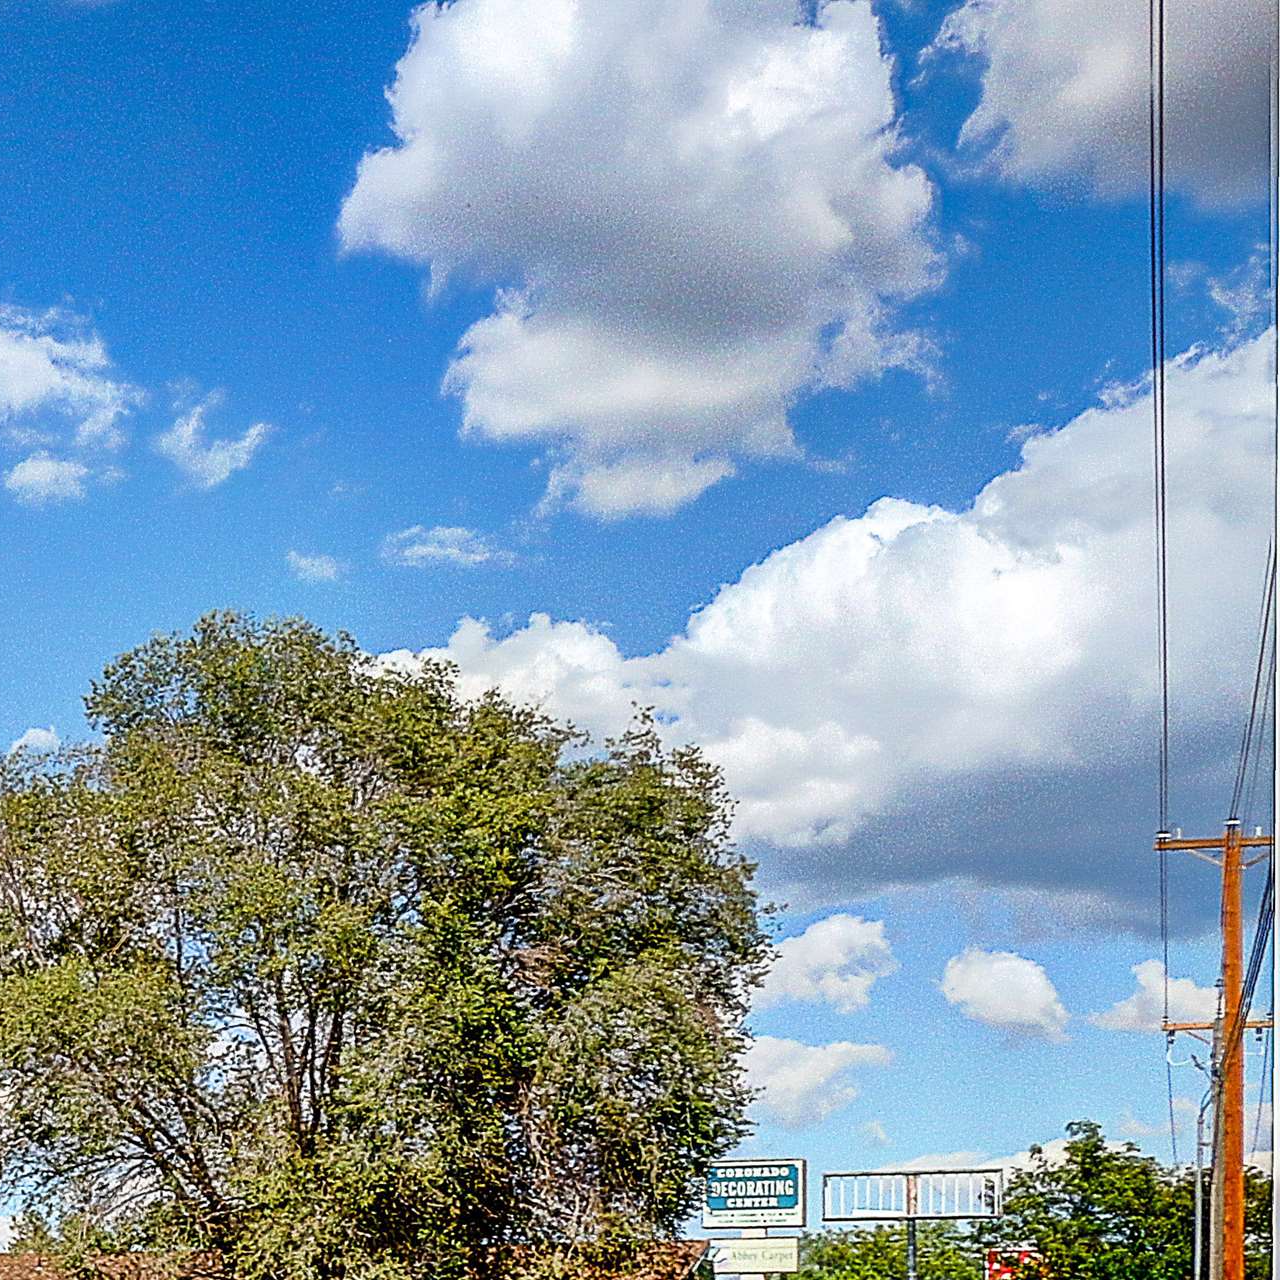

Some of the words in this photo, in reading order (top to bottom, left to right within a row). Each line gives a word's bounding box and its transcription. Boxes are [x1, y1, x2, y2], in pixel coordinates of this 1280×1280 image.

[716, 1166, 790, 1178] CORONADO
[710, 1179, 794, 1197] DECORATING
[726, 1197, 778, 1208] CENTER
